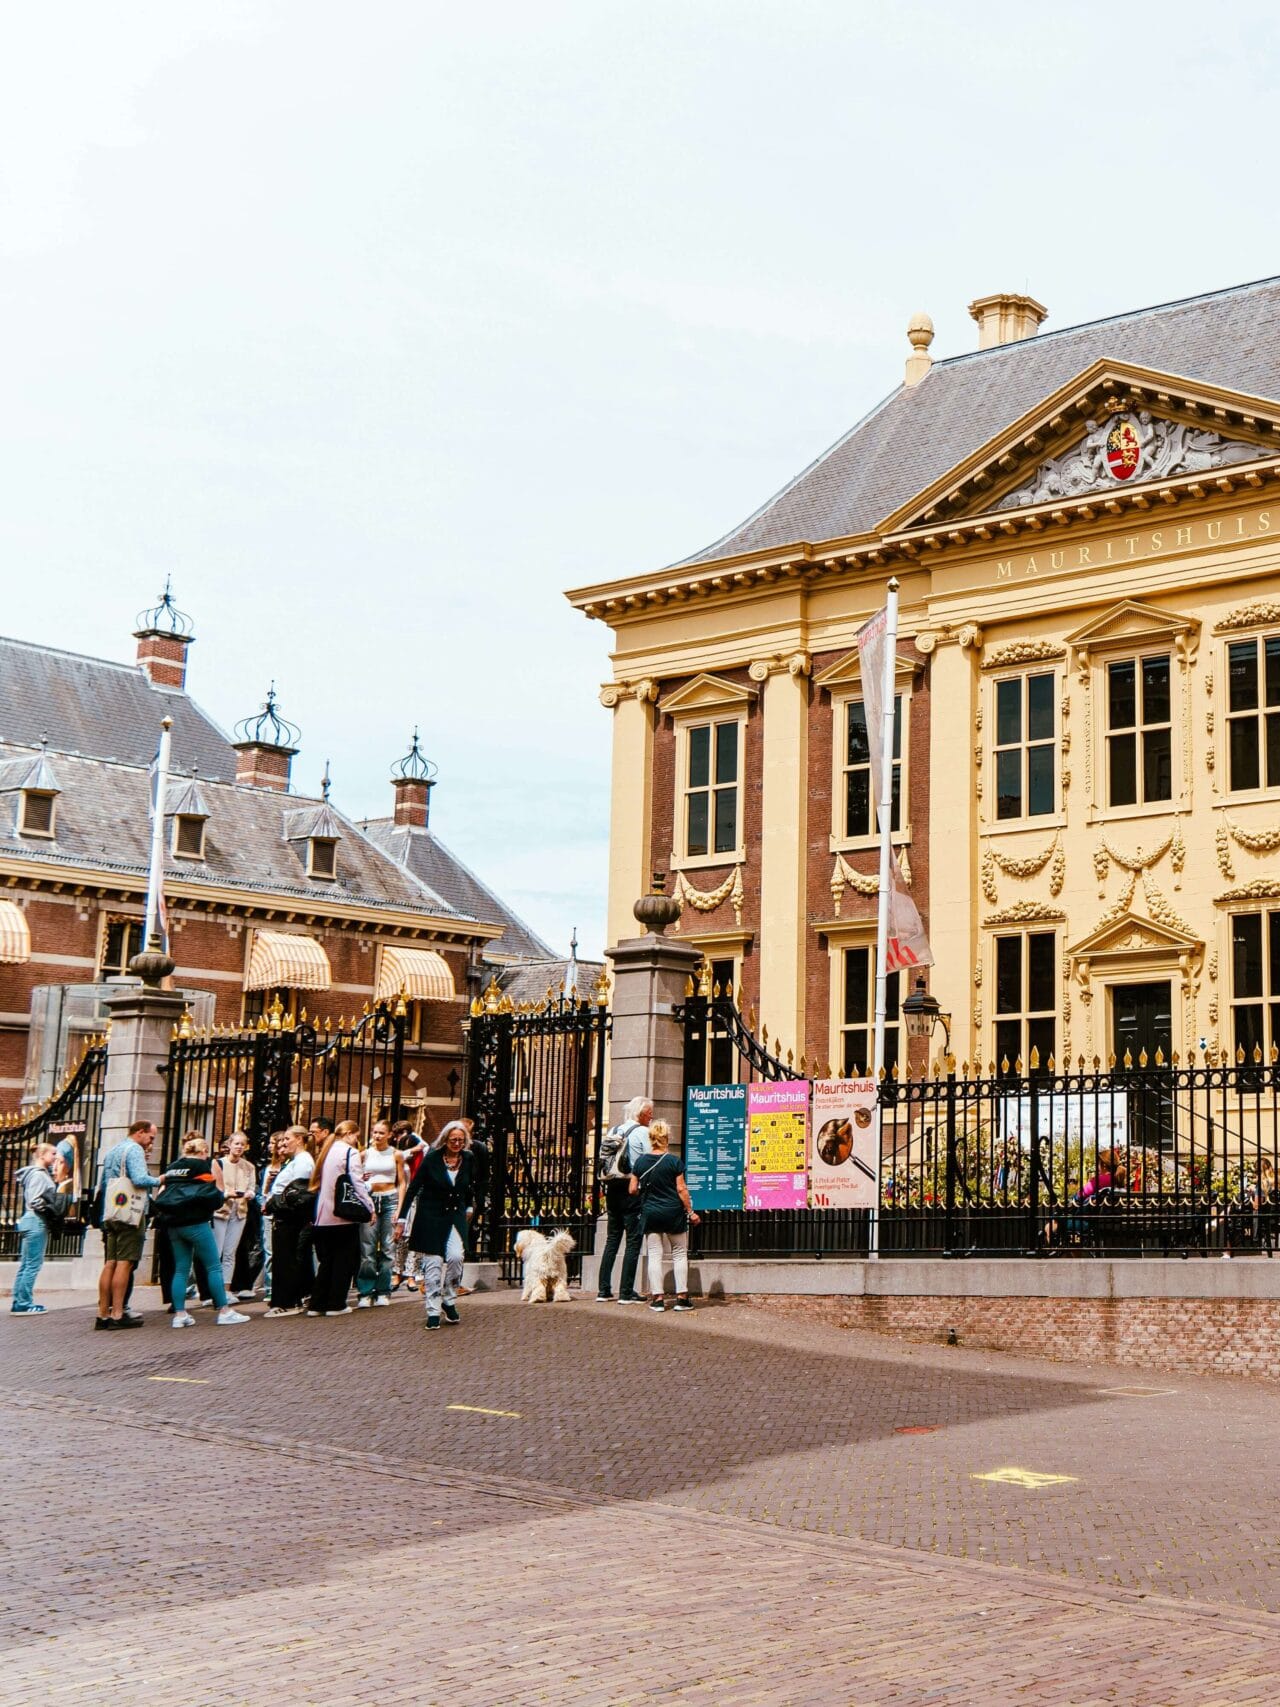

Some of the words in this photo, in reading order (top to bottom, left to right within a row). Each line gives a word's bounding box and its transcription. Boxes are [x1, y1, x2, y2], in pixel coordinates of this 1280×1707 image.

[996, 511, 1272, 580] MAURITSHUIS
[689, 1086, 745, 1101] Mauritshuis
[815, 1080, 874, 1095] Mauritshuis
[750, 1091, 806, 1104] Mauritshuis
